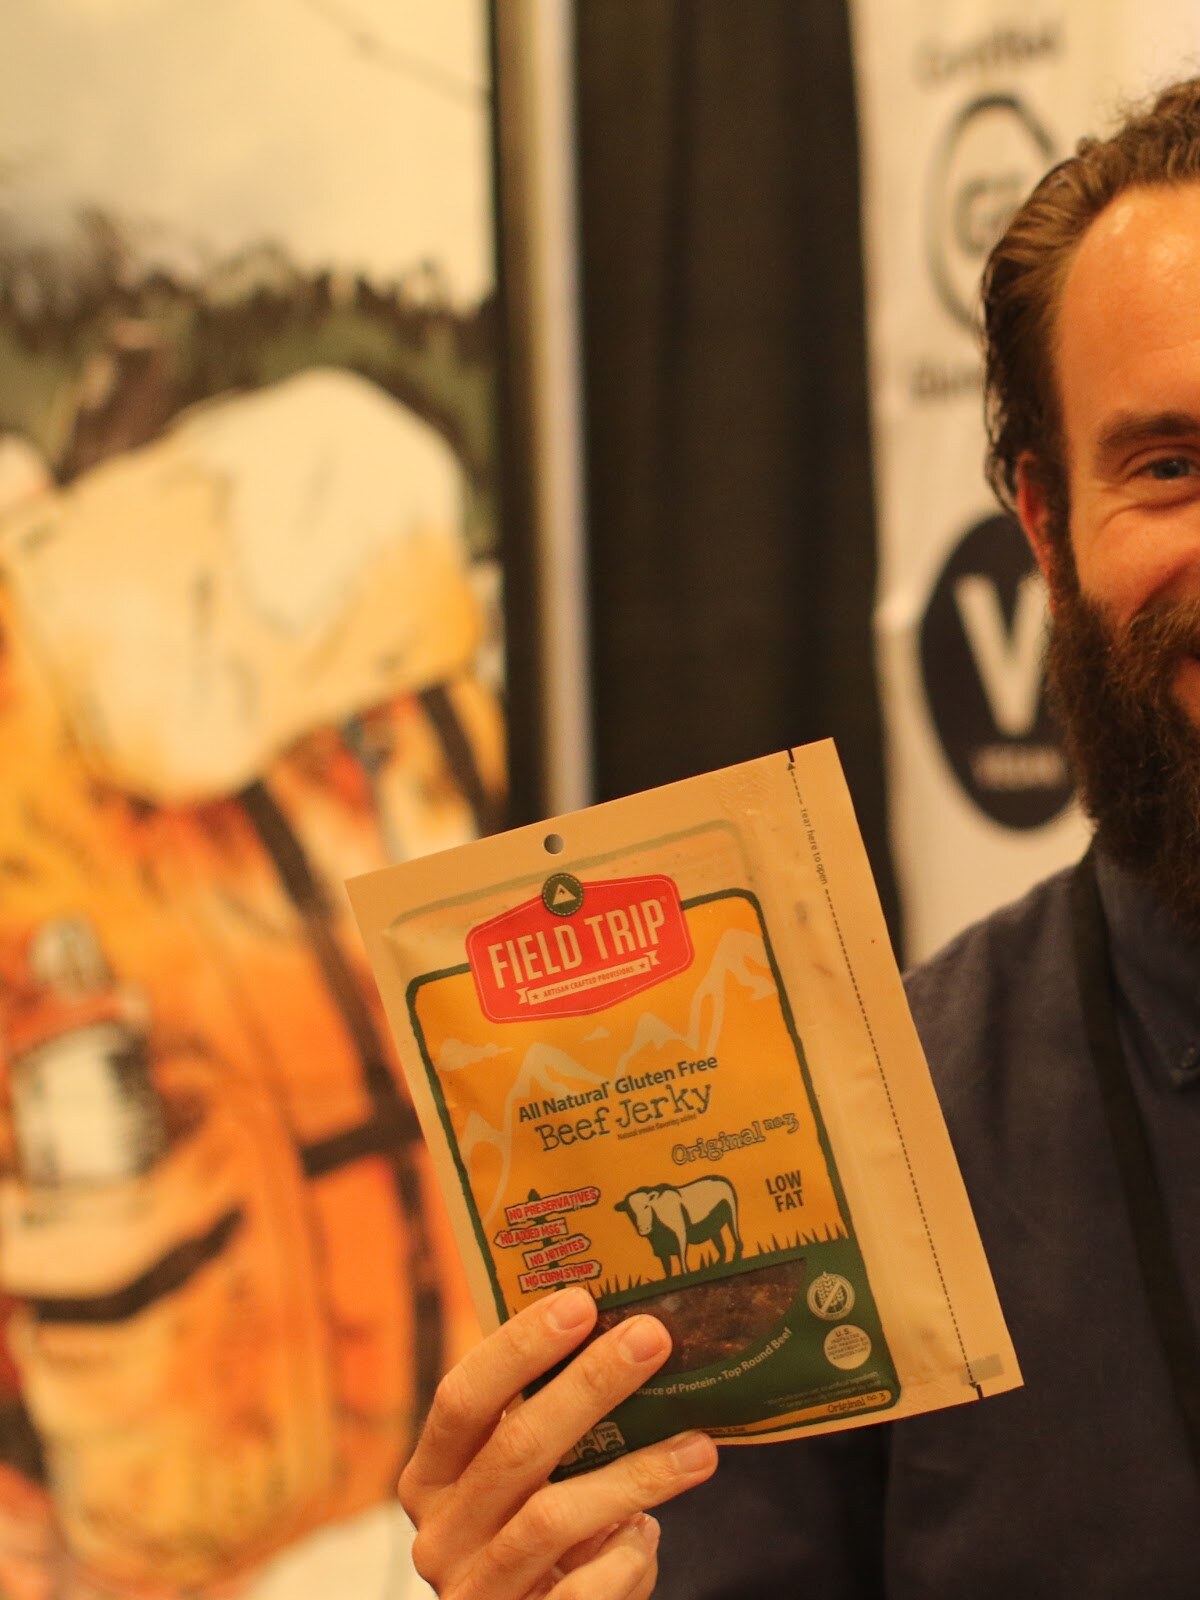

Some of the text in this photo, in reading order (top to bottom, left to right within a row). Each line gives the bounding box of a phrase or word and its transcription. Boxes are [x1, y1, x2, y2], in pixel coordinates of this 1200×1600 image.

[807, 829, 817, 850] here
[812, 852, 821, 863] to
[816, 863, 828, 885] open
[487, 898, 667, 990] FIELD TRIP
[570, 976, 597, 989] CRAFTED
[518, 1103, 541, 1123] All
[615, 1069, 676, 1095] Gluten
[677, 1056, 718, 1077] Free
[534, 1083, 713, 1152] Beef Jerky
[671, 1121, 765, 1165] Original
[765, 1169, 802, 1196] LOW
[507, 1189, 598, 1221] NO PRESERVATIVES
[774, 1189, 804, 1213] FAT
[500, 1232, 514, 1245] NO
[514, 1227, 540, 1242] ADDED
[529, 1238, 585, 1266] NO NITRITES
[524, 1262, 595, 1288] NO CORN SYRUP
[665, 1383, 678, 1395] of
[678, 1376, 716, 1393] Protein
[721, 1366, 742, 1381] Top
[740, 1347, 774, 1370] Round
[771, 1326, 793, 1350] Beef
